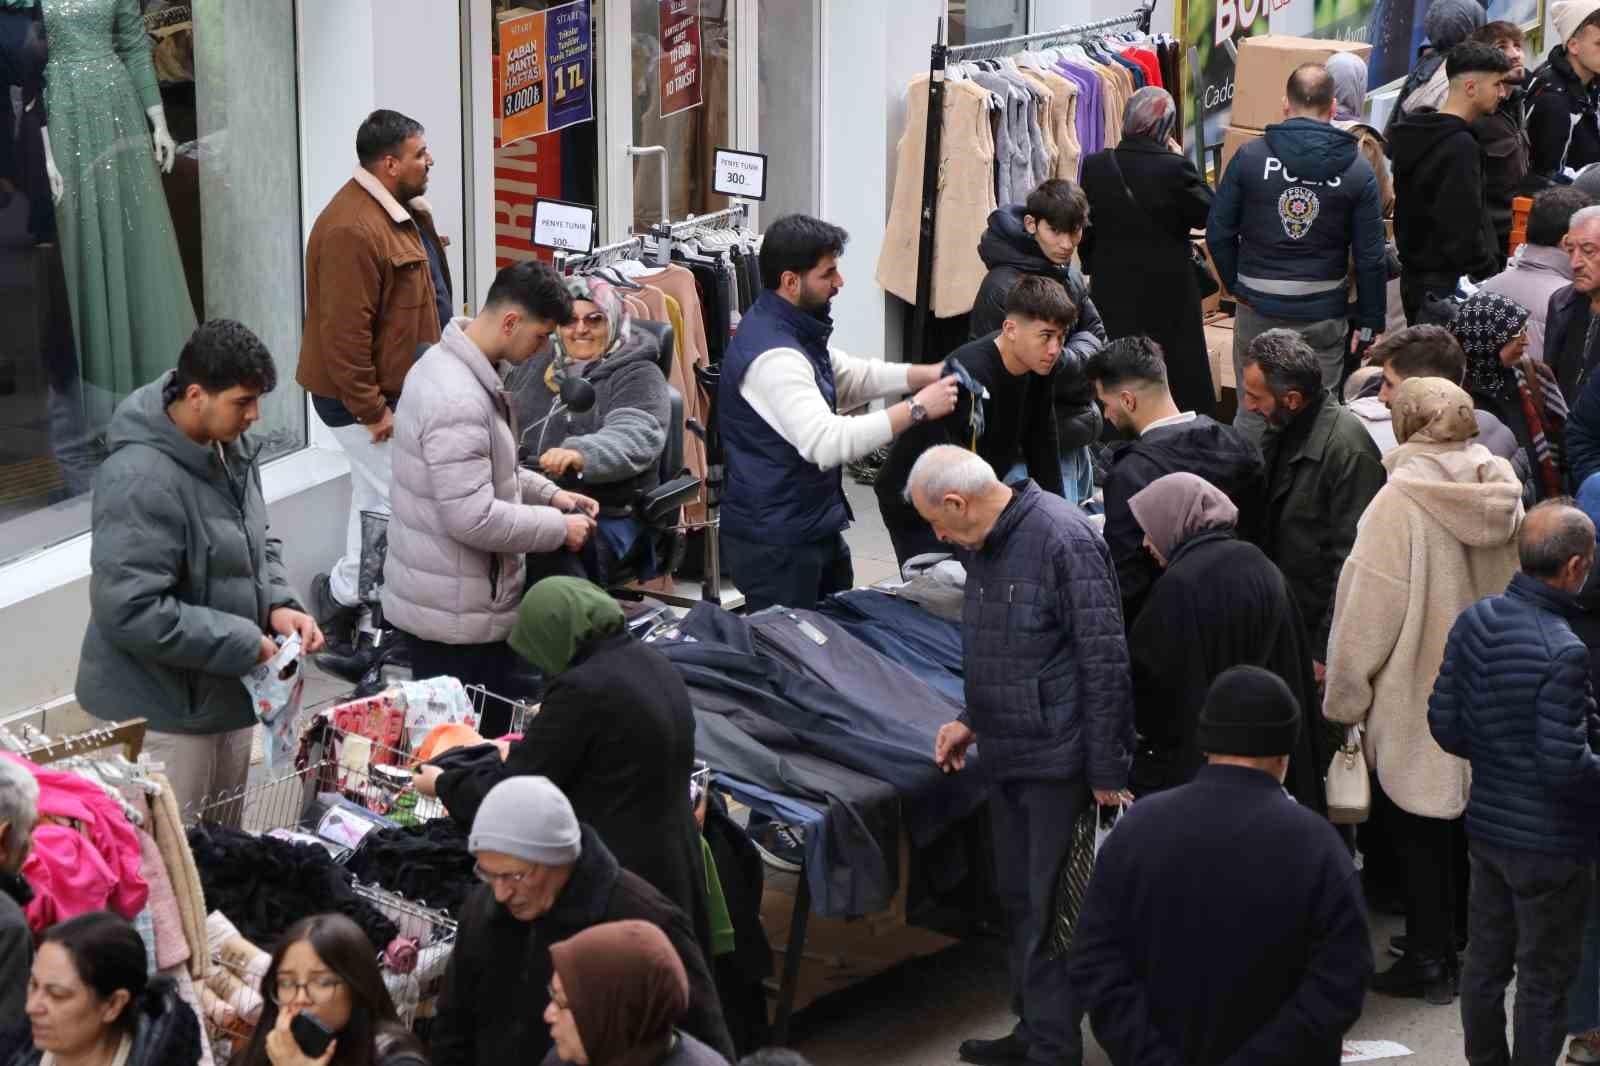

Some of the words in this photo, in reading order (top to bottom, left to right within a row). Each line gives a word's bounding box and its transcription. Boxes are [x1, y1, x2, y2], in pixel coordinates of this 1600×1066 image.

[507, 40, 537, 62] KABAN
[507, 55, 538, 76] MANTO
[554, 65, 566, 101] 1
[567, 63, 585, 89] TL
[666, 81, 674, 97] 10
[727, 172, 745, 185] 300
[541, 218, 564, 228] PENYE
[552, 237, 568, 247] 300
